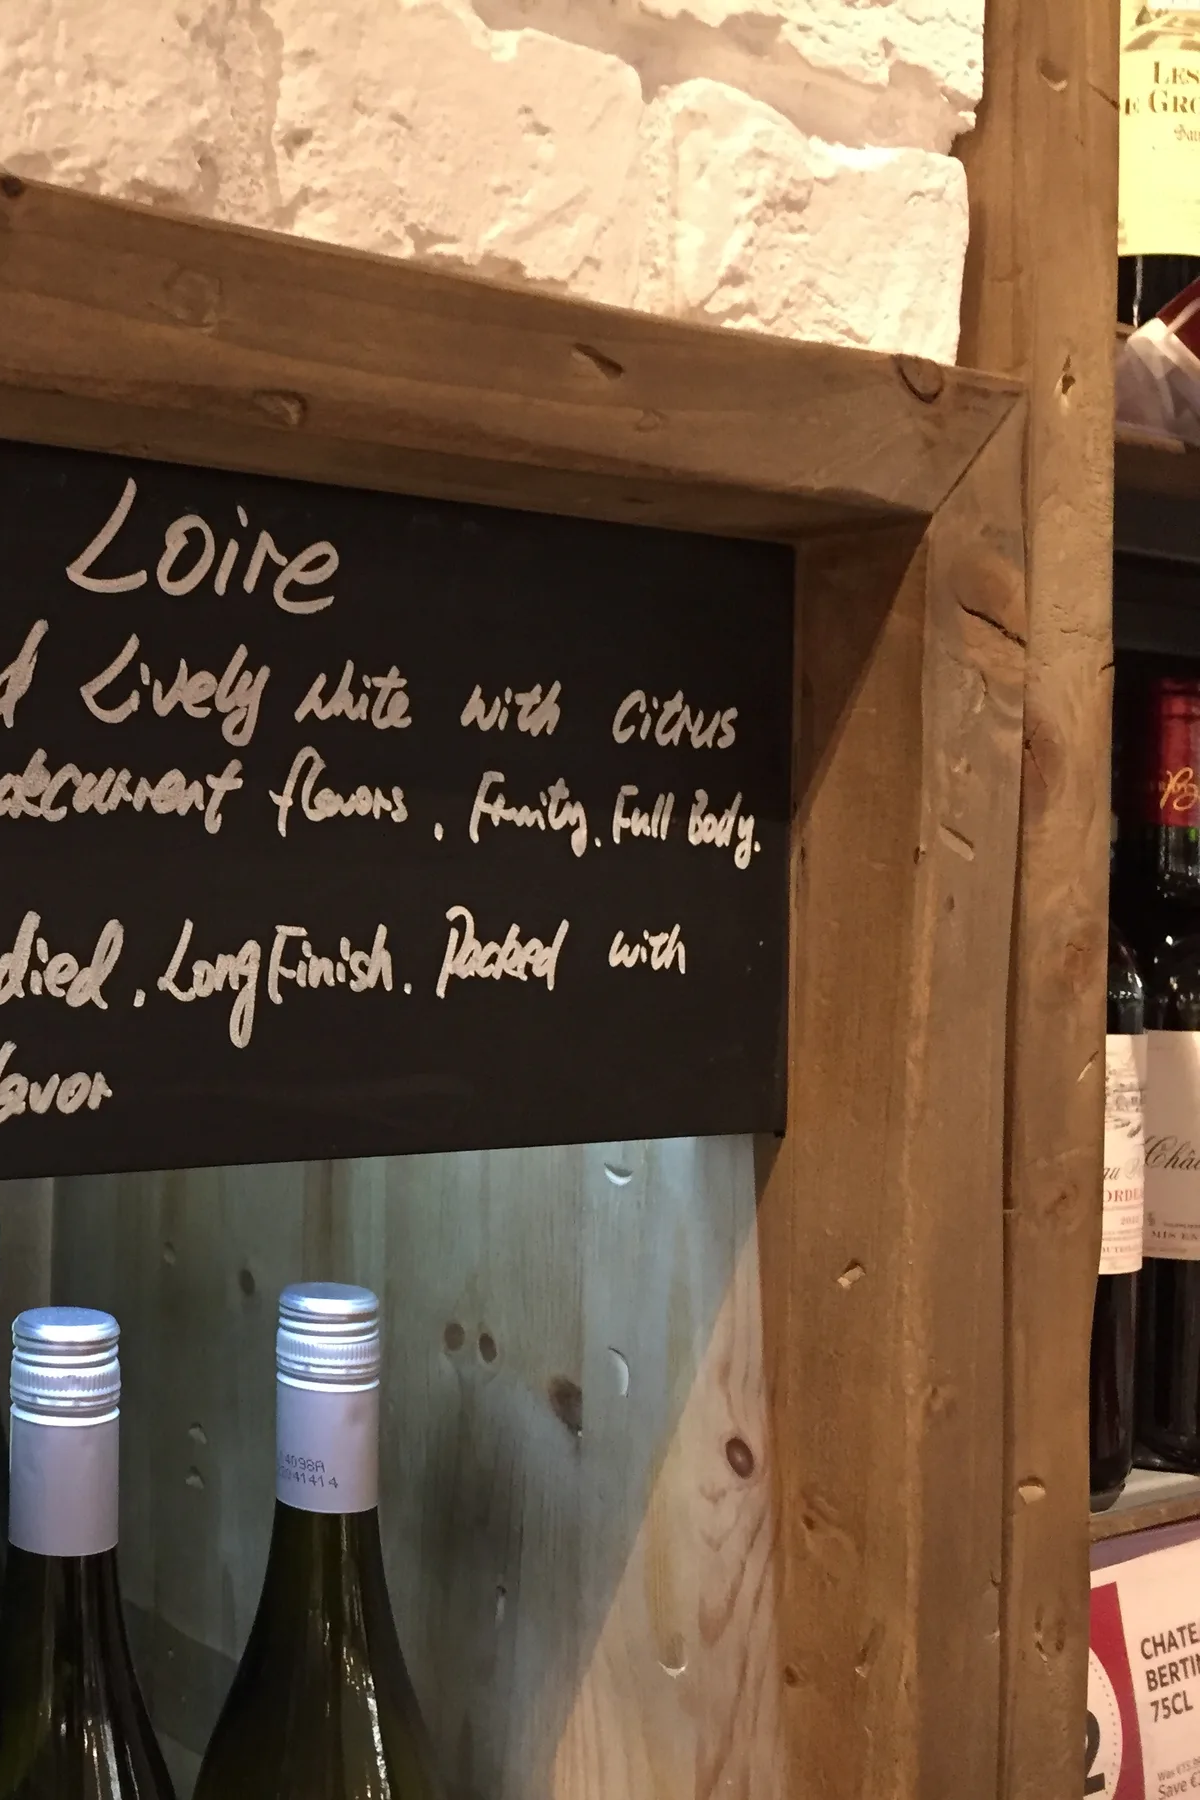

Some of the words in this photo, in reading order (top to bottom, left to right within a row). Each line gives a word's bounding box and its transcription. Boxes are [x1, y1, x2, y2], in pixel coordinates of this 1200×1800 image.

[66, 478, 339, 614] Loire
[80, 634, 270, 746] Lively
[461, 681, 561, 737] with
[612, 785, 674, 844] Full
[436, 906, 569, 999] Packed
[609, 924, 685, 974] with
[1150, 1690, 1194, 1723] 75CL
